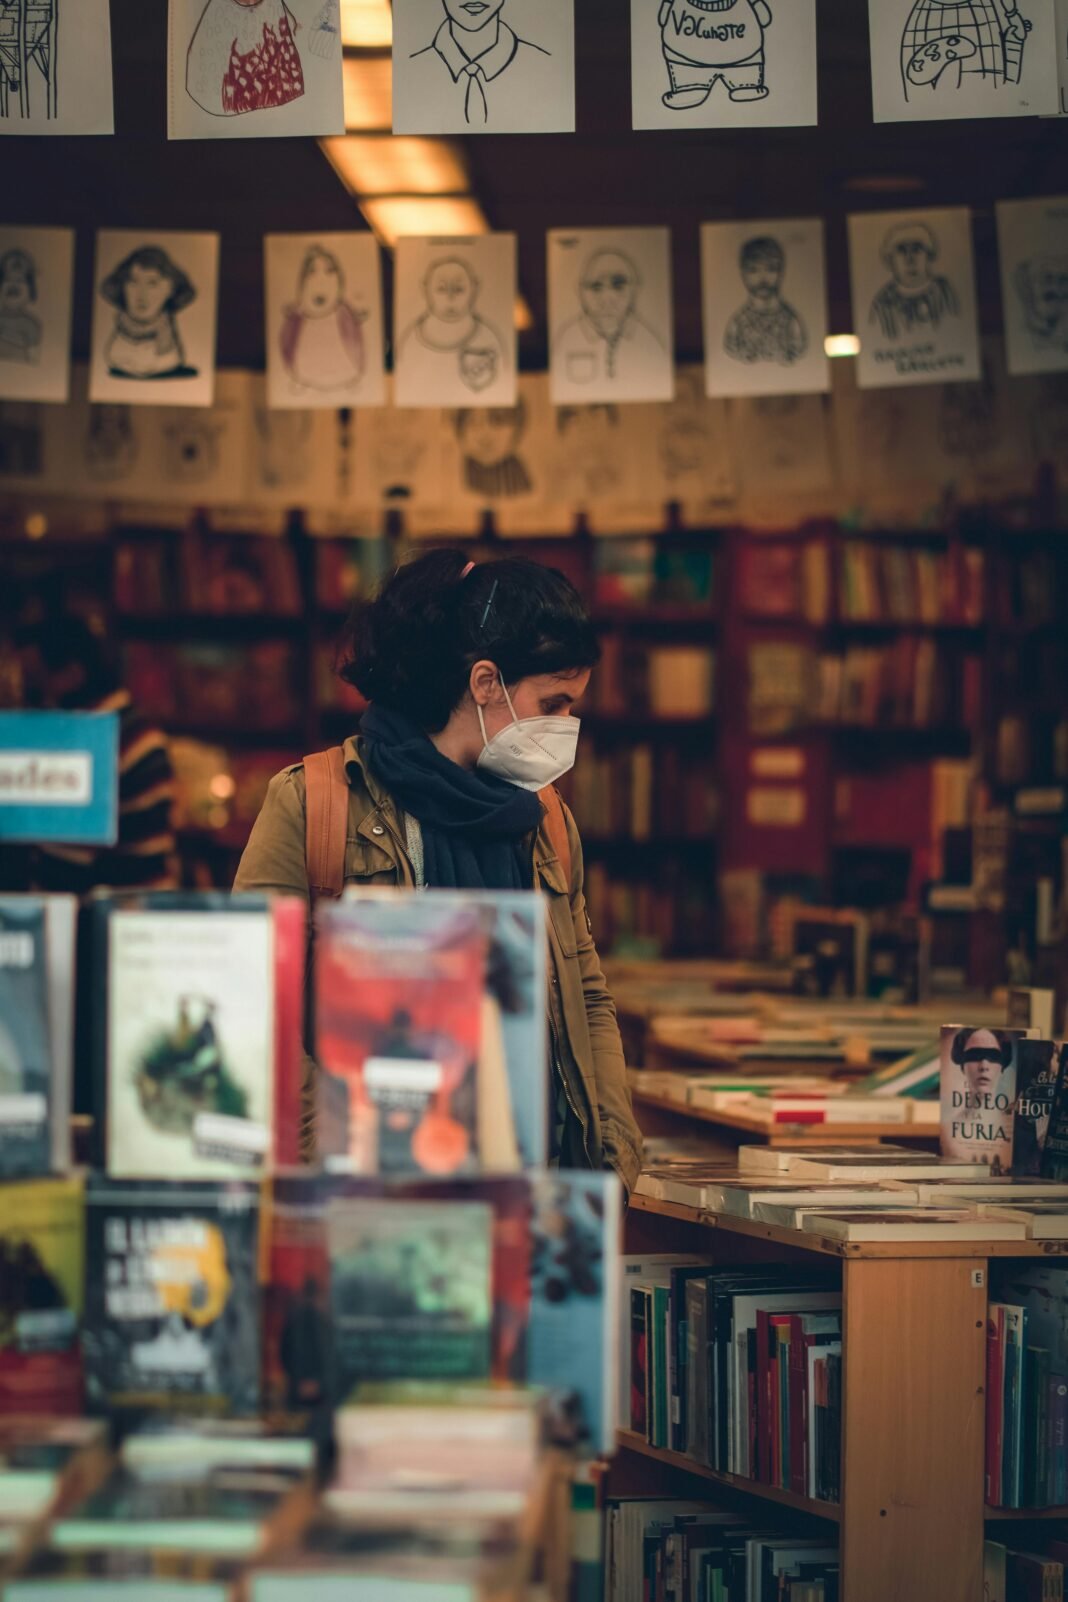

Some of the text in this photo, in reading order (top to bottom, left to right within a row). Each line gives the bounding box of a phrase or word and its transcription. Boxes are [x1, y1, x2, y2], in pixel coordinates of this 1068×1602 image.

[952, 1090, 1009, 1111] DESEO
[952, 1121, 1009, 1142] FURIA
[976, 1272, 982, 1284] E
